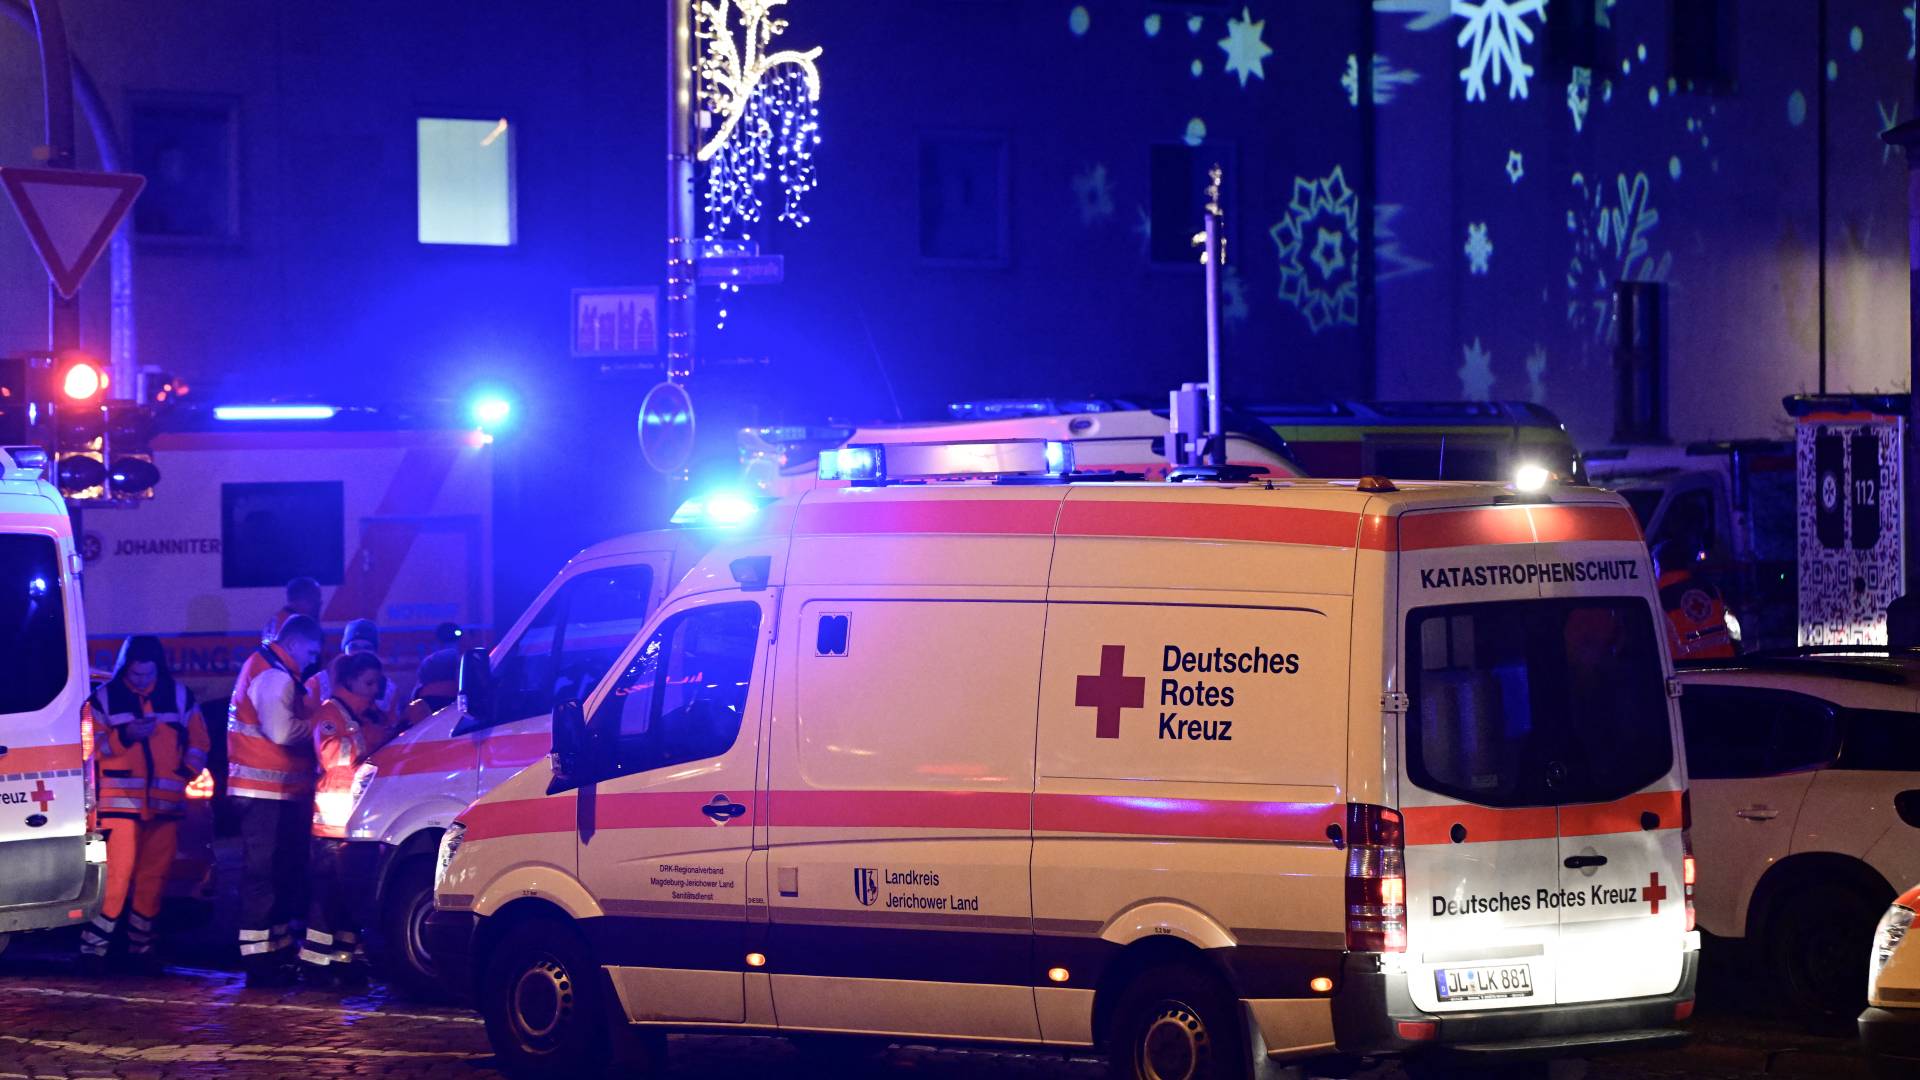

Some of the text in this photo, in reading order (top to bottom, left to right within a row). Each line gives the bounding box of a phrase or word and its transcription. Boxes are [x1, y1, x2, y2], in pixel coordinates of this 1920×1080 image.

[1855, 479, 1875, 505] 112
[114, 538, 221, 556] JOHANNITER
[1421, 560, 1639, 589] KATASTROPHENSCHUTZ
[1162, 644, 1299, 674] Deutsches
[1160, 678, 1235, 707] Rotes
[1158, 712, 1233, 741] Kreuz
[659, 864, 724, 875] DRK-Regionalverband
[885, 869, 940, 886] Landkreis
[719, 880, 735, 889] Land
[885, 892, 979, 911] Jerichower Land
[1432, 884, 1637, 917] Deutsches Rotes Kreuz
[1477, 970, 1498, 990] LK
[1501, 968, 1529, 989] 881
